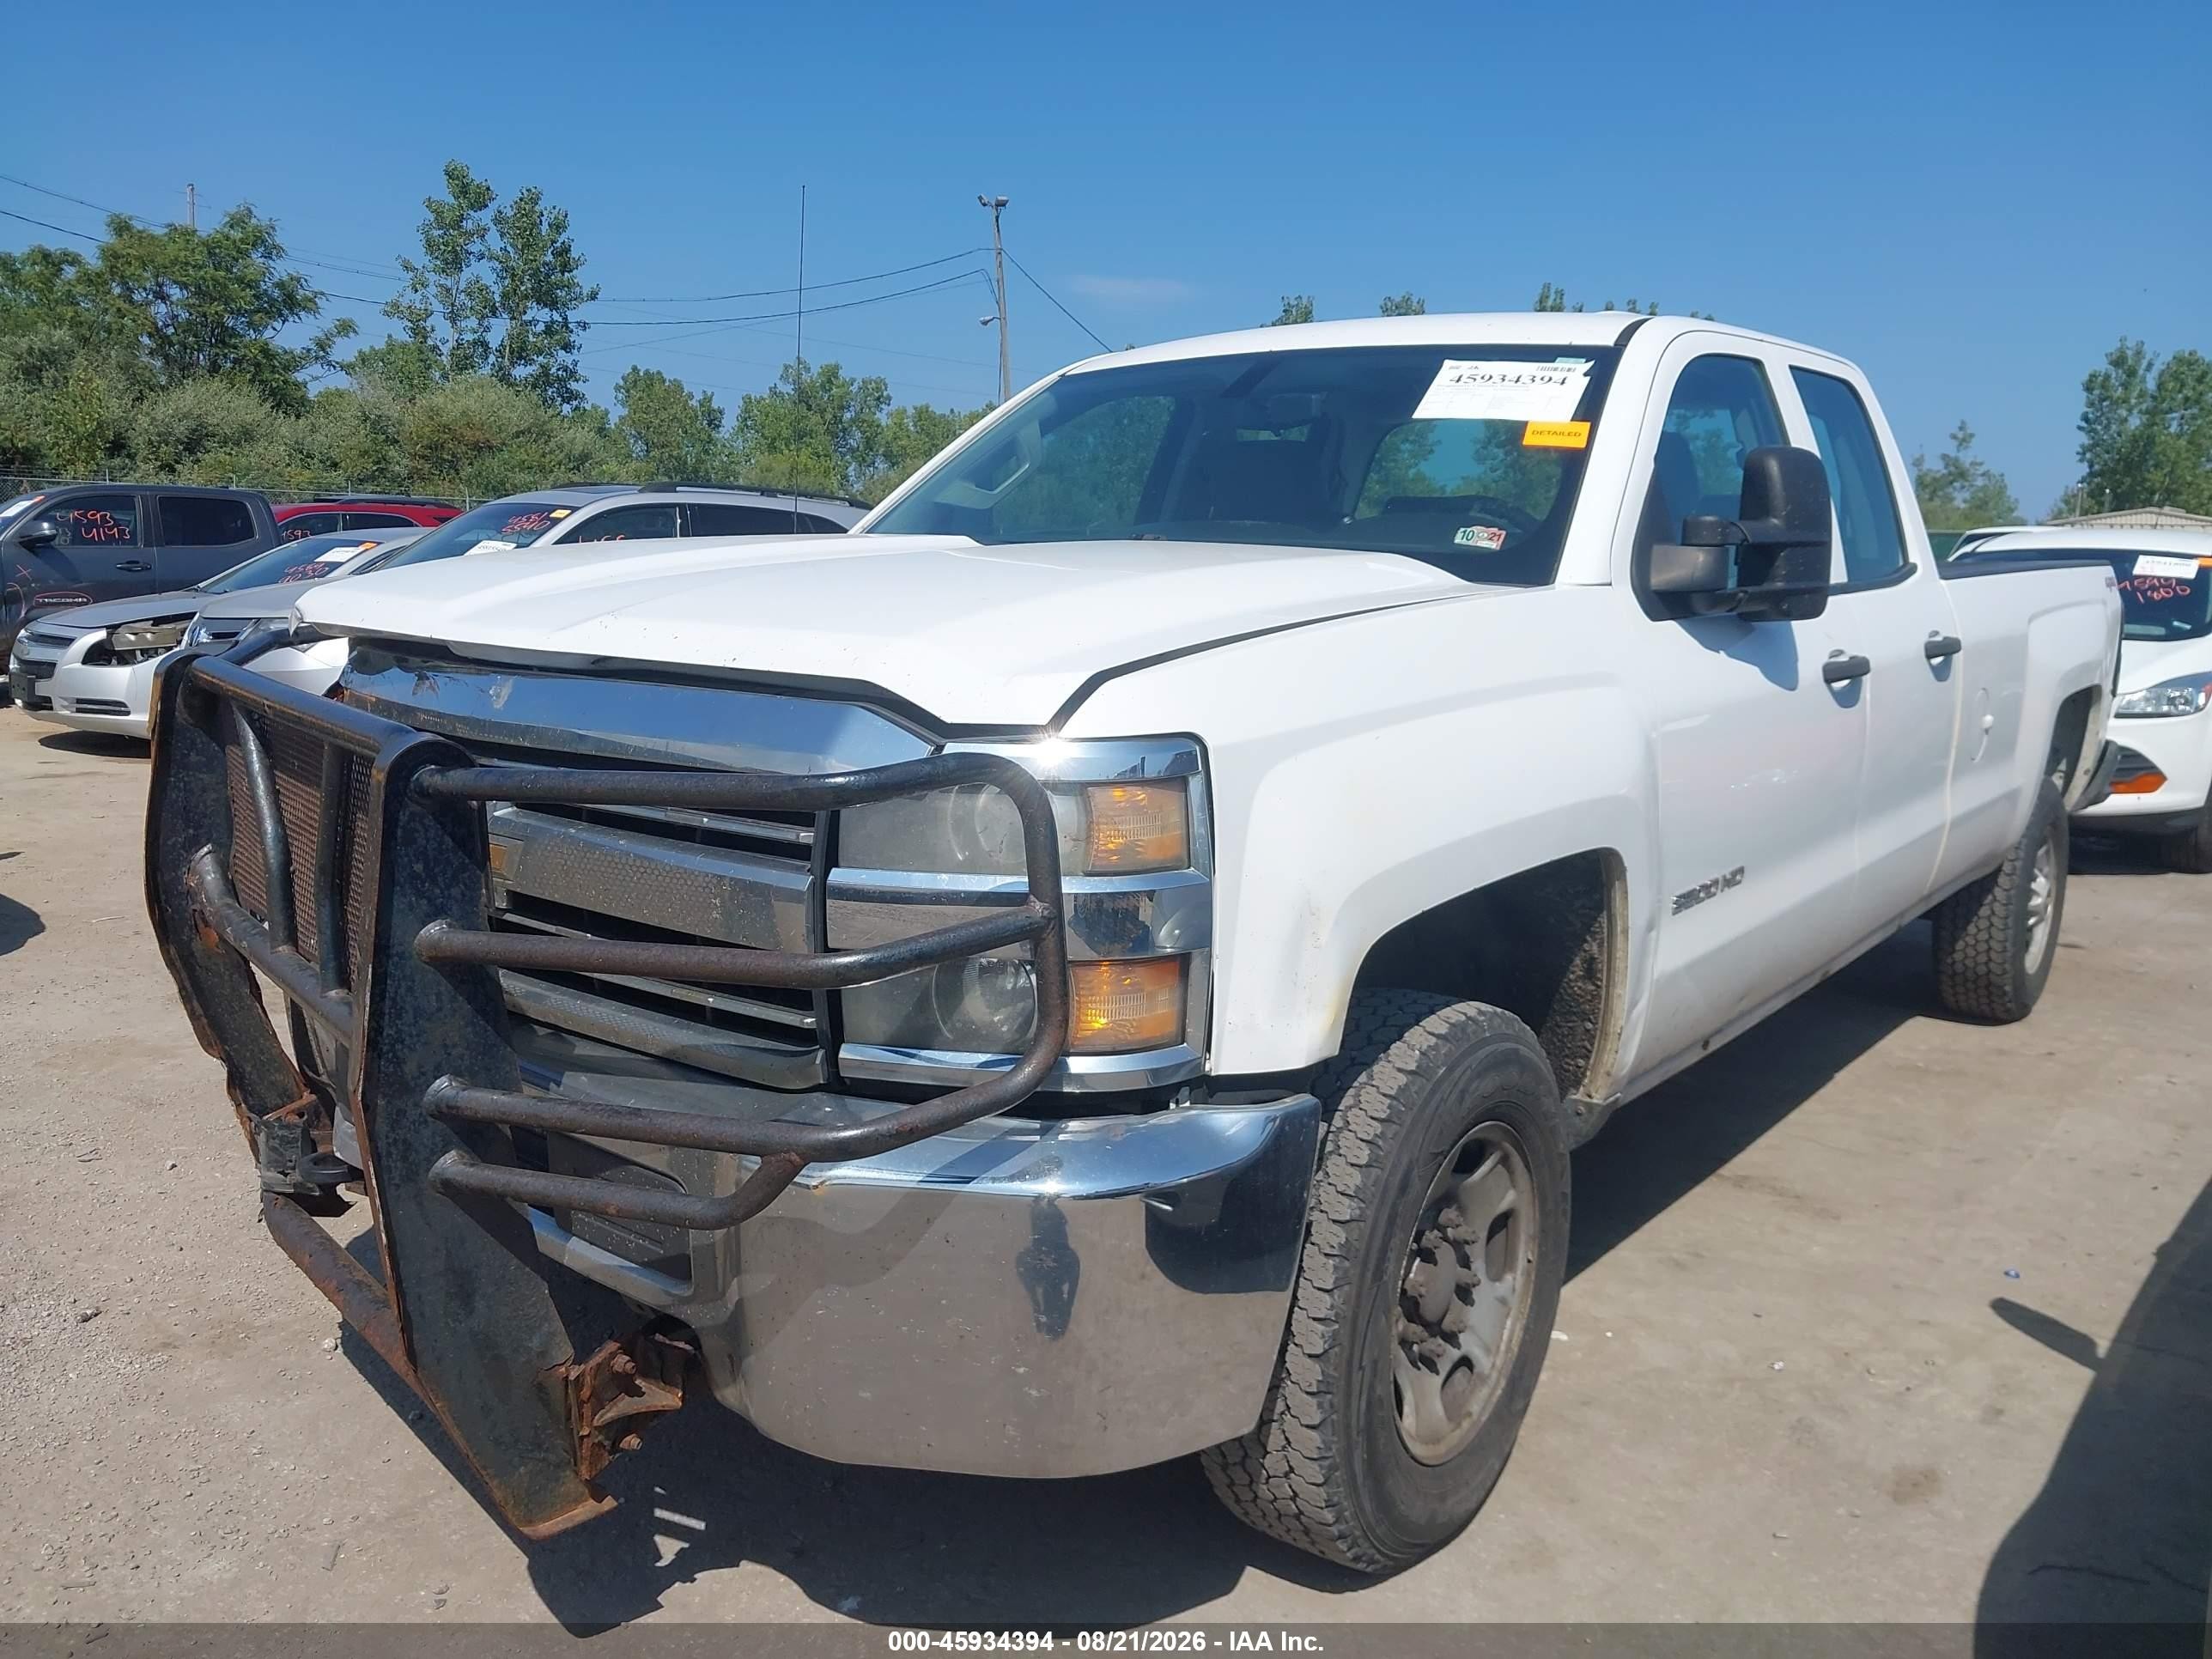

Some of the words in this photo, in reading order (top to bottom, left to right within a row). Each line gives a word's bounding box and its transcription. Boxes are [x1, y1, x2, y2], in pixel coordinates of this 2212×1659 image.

[1449, 373, 1570, 386] 45934394
[1530, 428, 1583, 438] DETAILED
[56, 509, 115, 526] 4593
[81, 526, 131, 542] 4143
[1460, 529, 1475, 541] 10
[1488, 532, 1503, 542] 21
